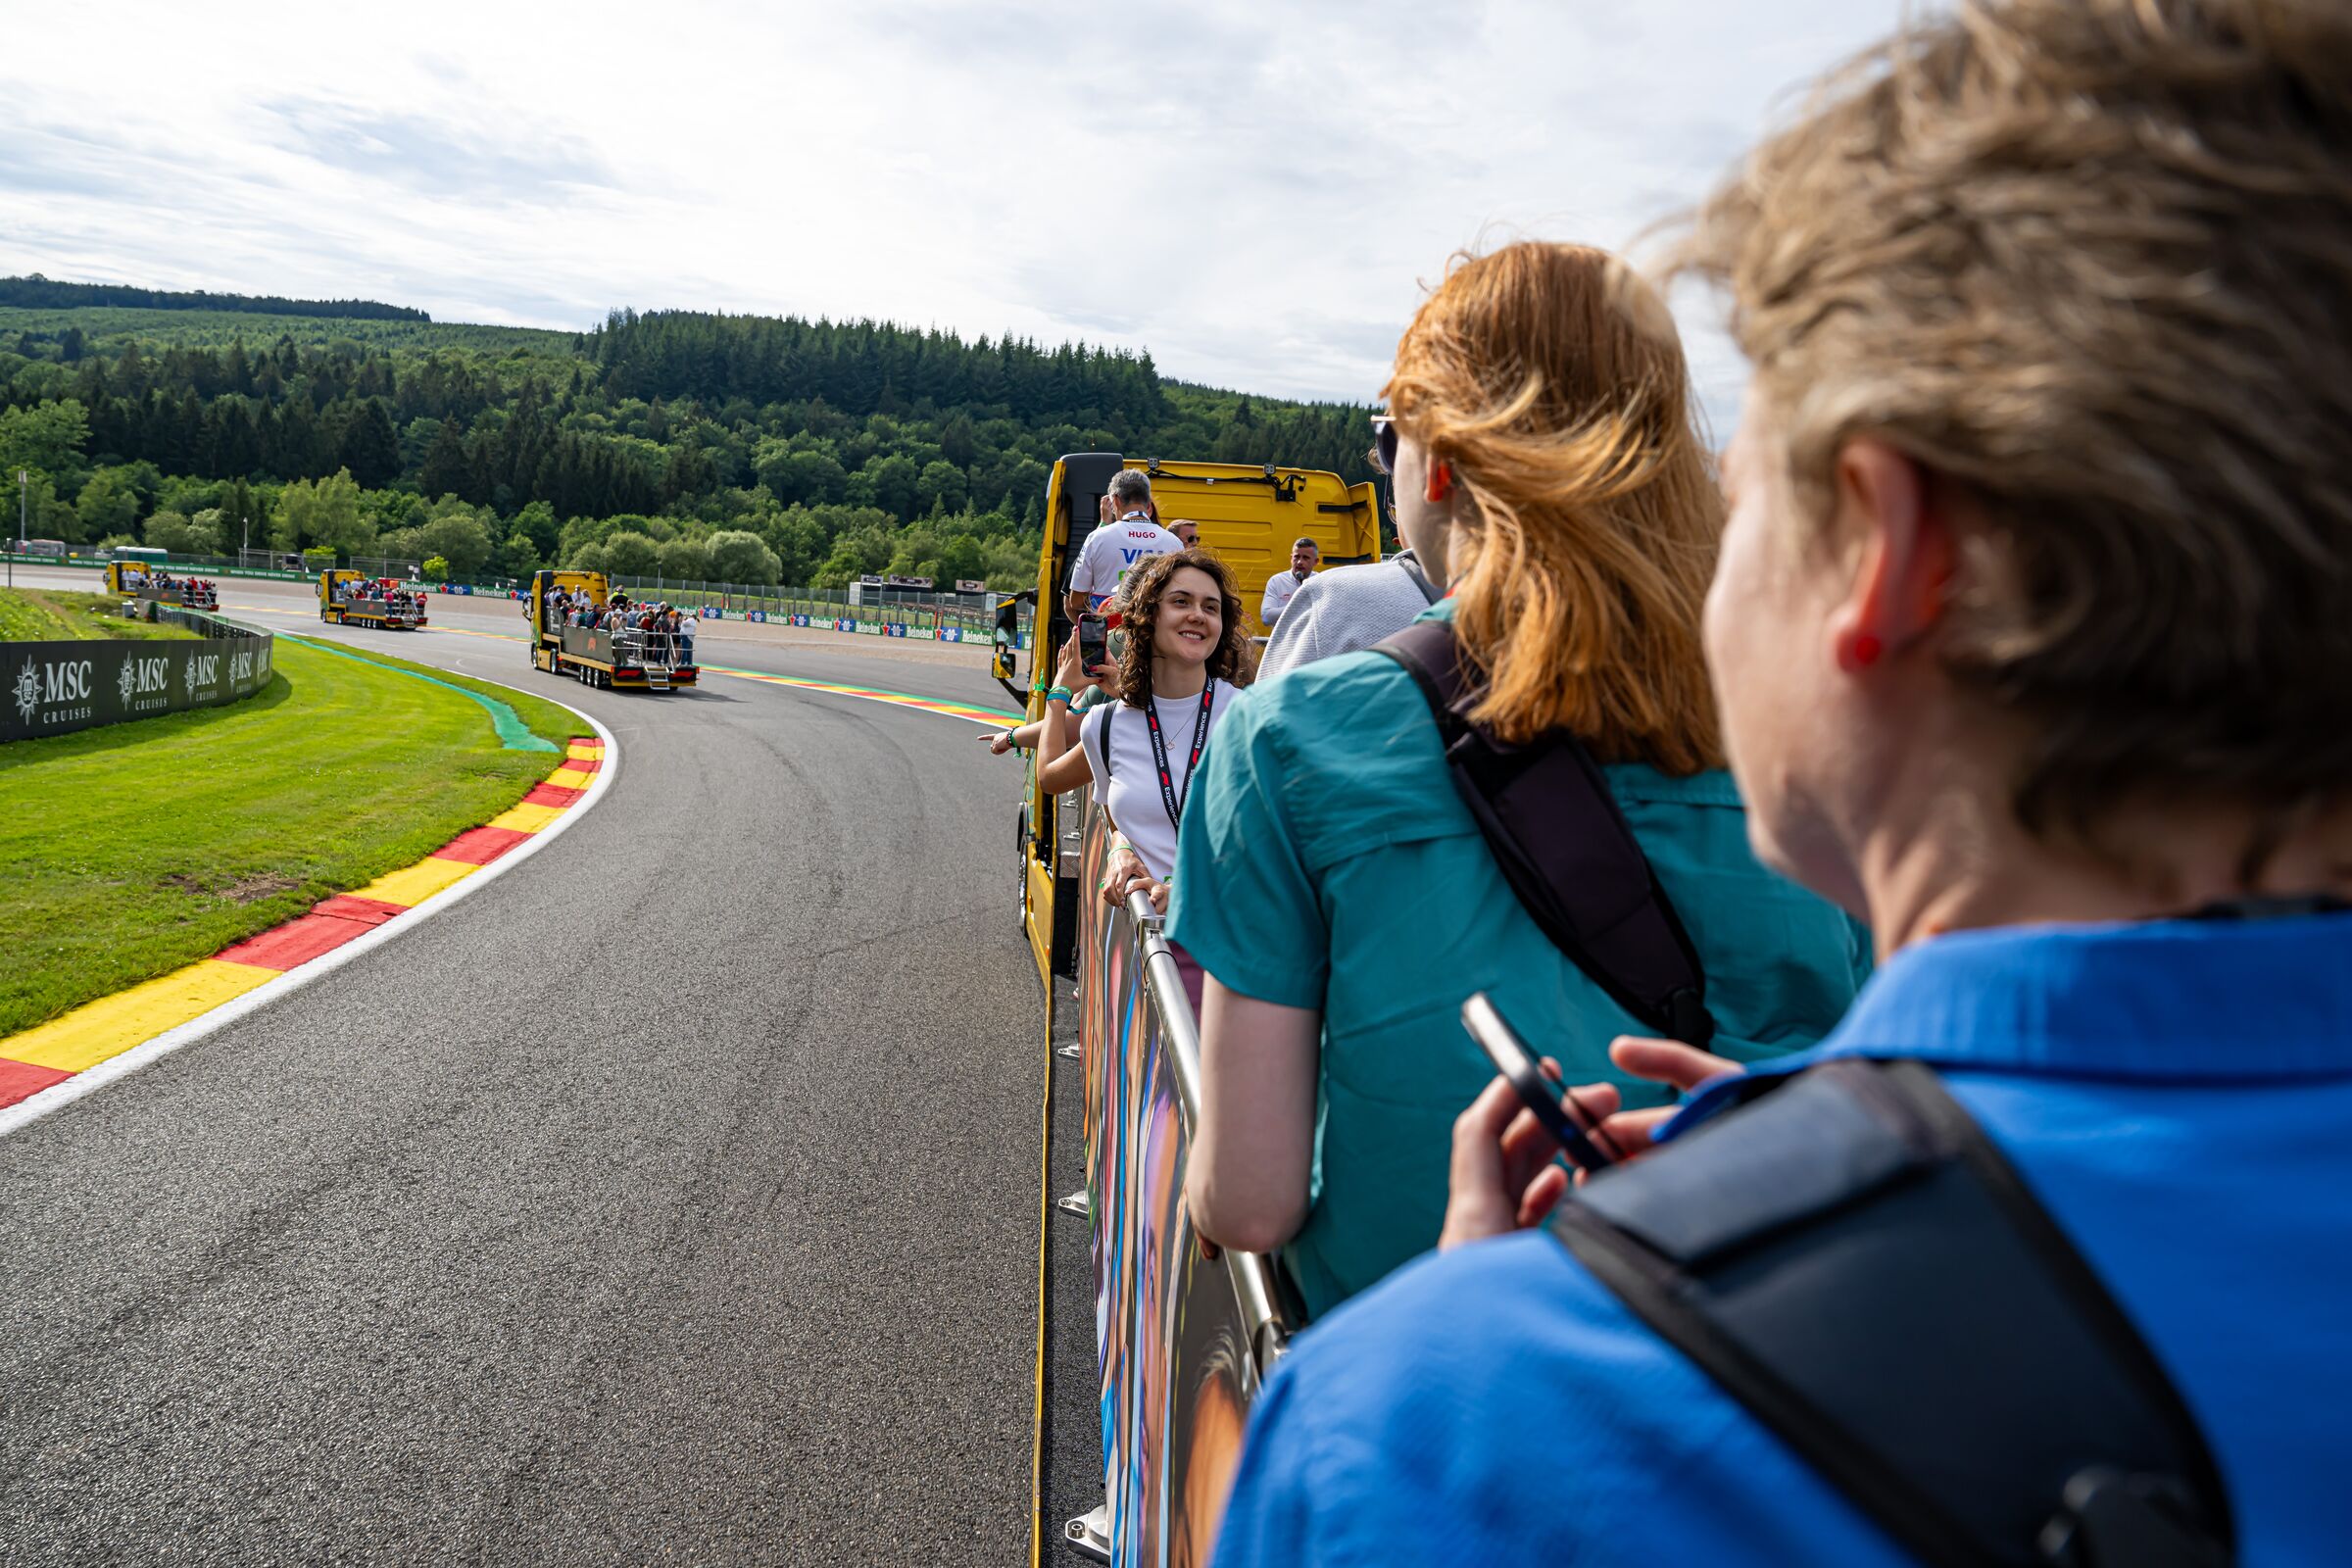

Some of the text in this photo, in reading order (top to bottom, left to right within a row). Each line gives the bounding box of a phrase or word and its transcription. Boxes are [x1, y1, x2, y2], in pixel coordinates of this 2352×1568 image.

[400, 580, 437, 593] Heineken
[472, 587, 507, 599] Heineken
[721, 609, 746, 620] Heineken
[906, 627, 934, 639] Heineken
[962, 629, 994, 646] Heineken
[136, 657, 169, 693] MSC
[196, 655, 219, 686] MSC
[44, 660, 92, 704] MSC
[135, 698, 168, 711] CRUISES
[43, 707, 92, 724] CRUISES
[1195, 711, 1207, 749] Experiences
[1152, 731, 1164, 767] Experiences
